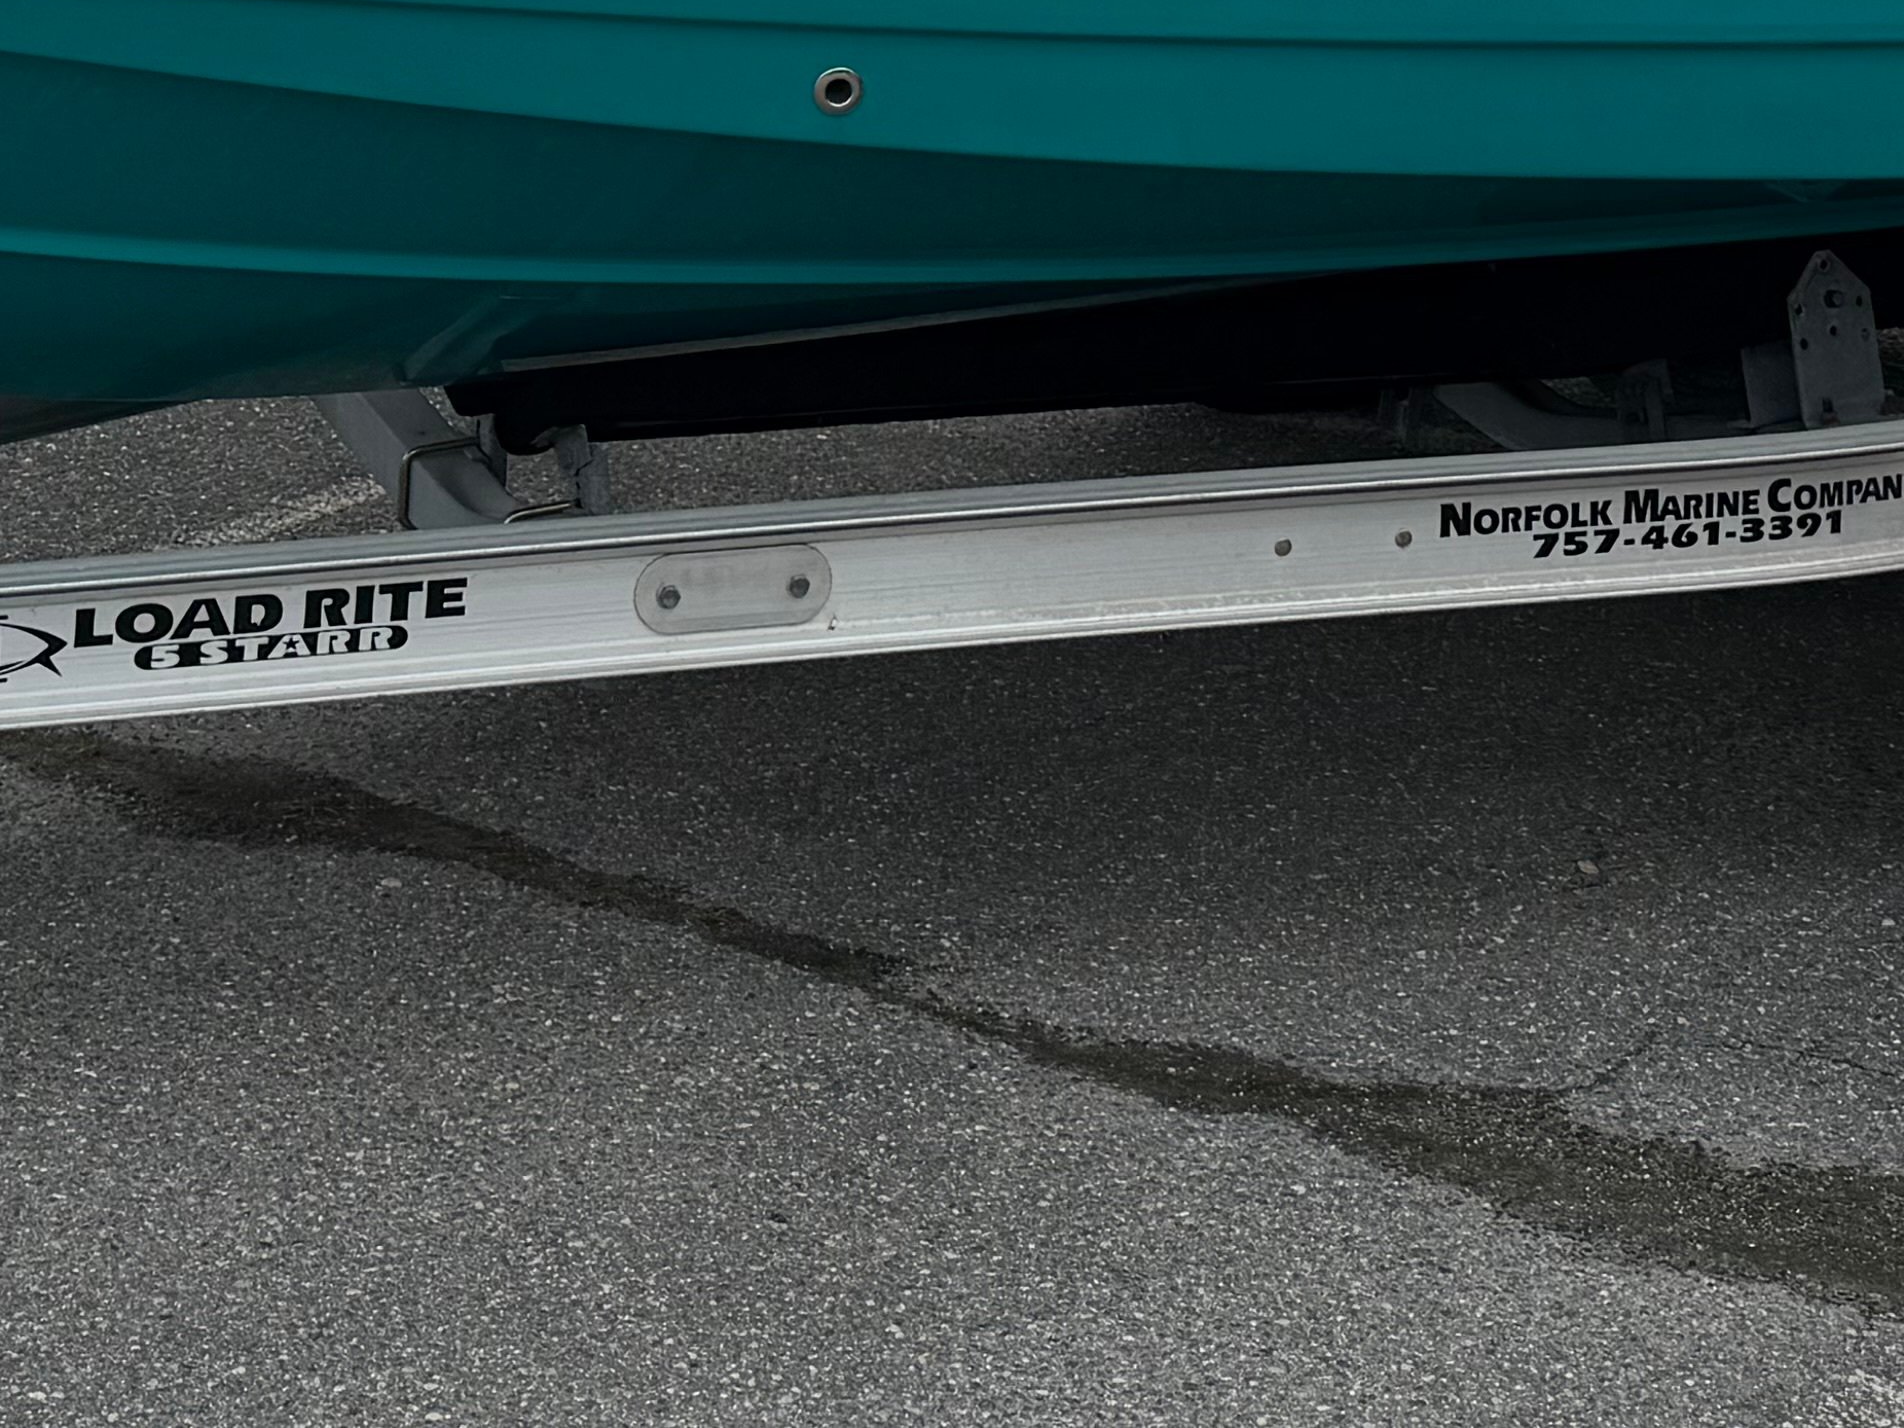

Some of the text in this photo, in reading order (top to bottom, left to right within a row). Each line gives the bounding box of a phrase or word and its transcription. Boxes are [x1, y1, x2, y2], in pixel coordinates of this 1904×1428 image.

[1439, 500, 1613, 538] NORFOLK
[1622, 488, 1760, 525] MARINE
[1532, 510, 1843, 559] 757-461-3391
[73, 577, 469, 648] LOAD RITE
[149, 626, 394, 669] 5 STARR
